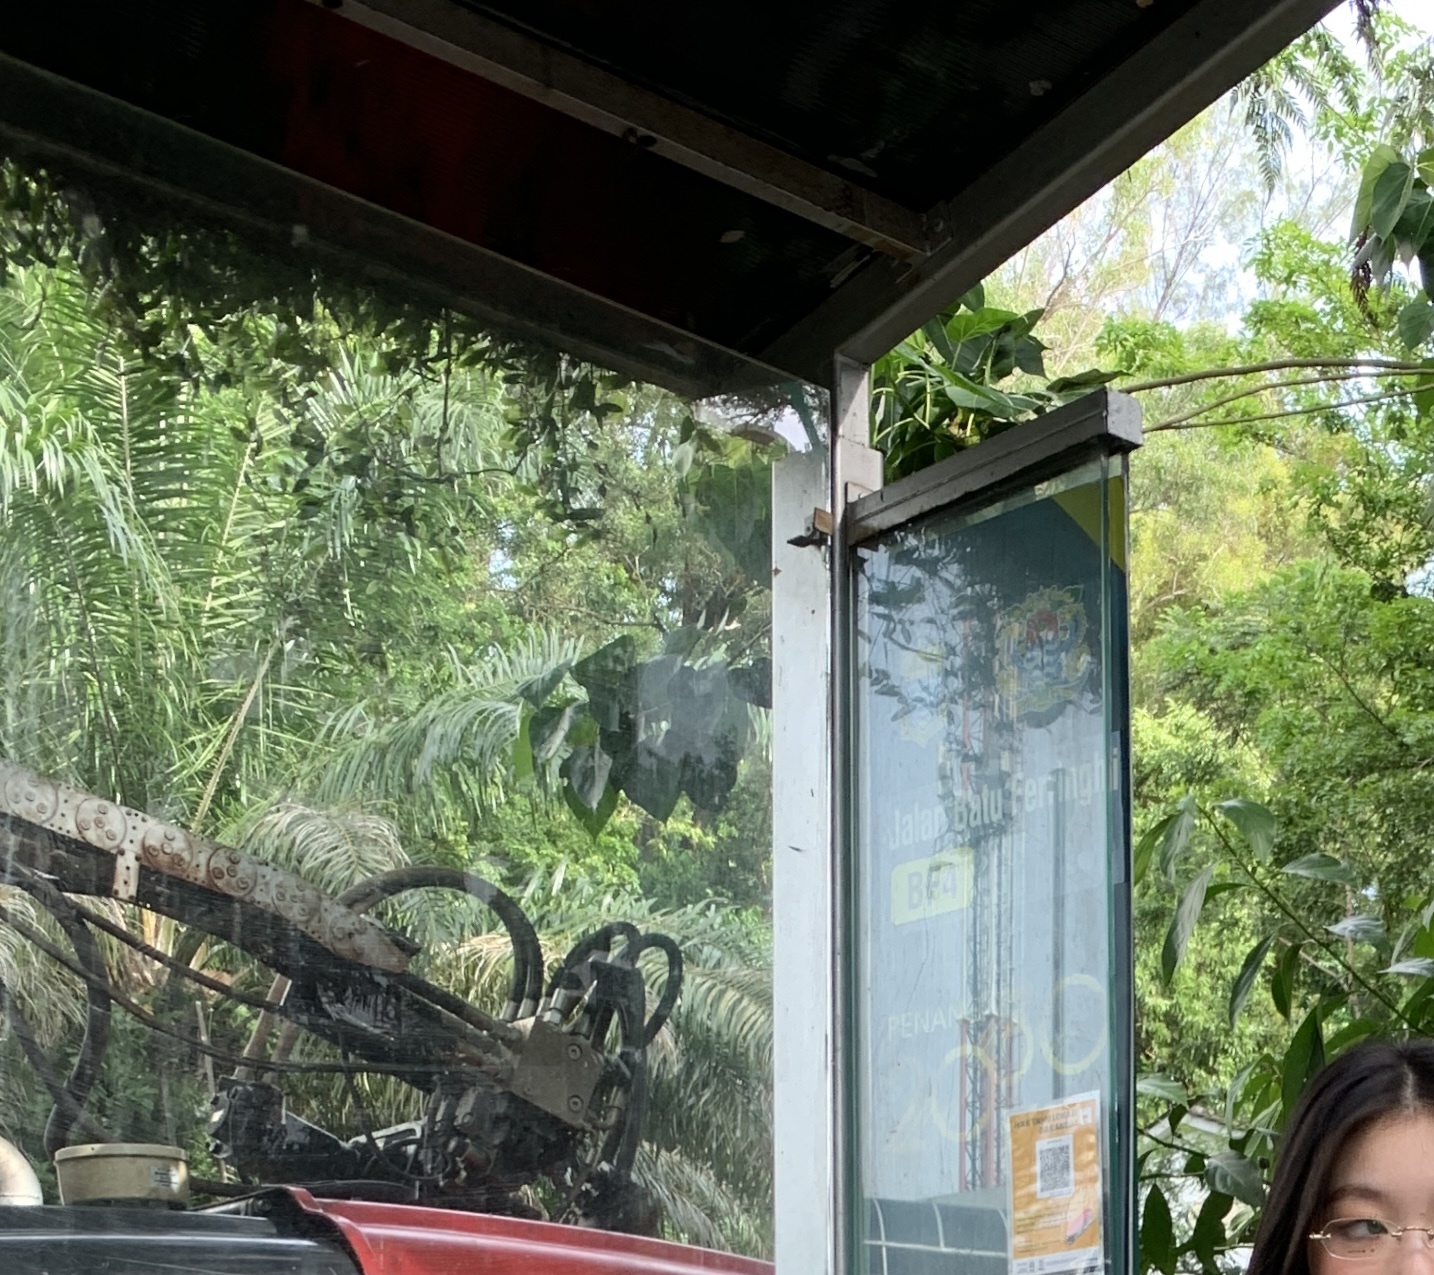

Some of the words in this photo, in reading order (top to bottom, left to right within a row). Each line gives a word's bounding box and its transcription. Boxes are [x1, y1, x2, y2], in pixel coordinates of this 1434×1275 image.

[889, 801, 949, 851] Jalan
[954, 784, 1003, 832] Batu
[887, 1003, 965, 1042] PENAN
